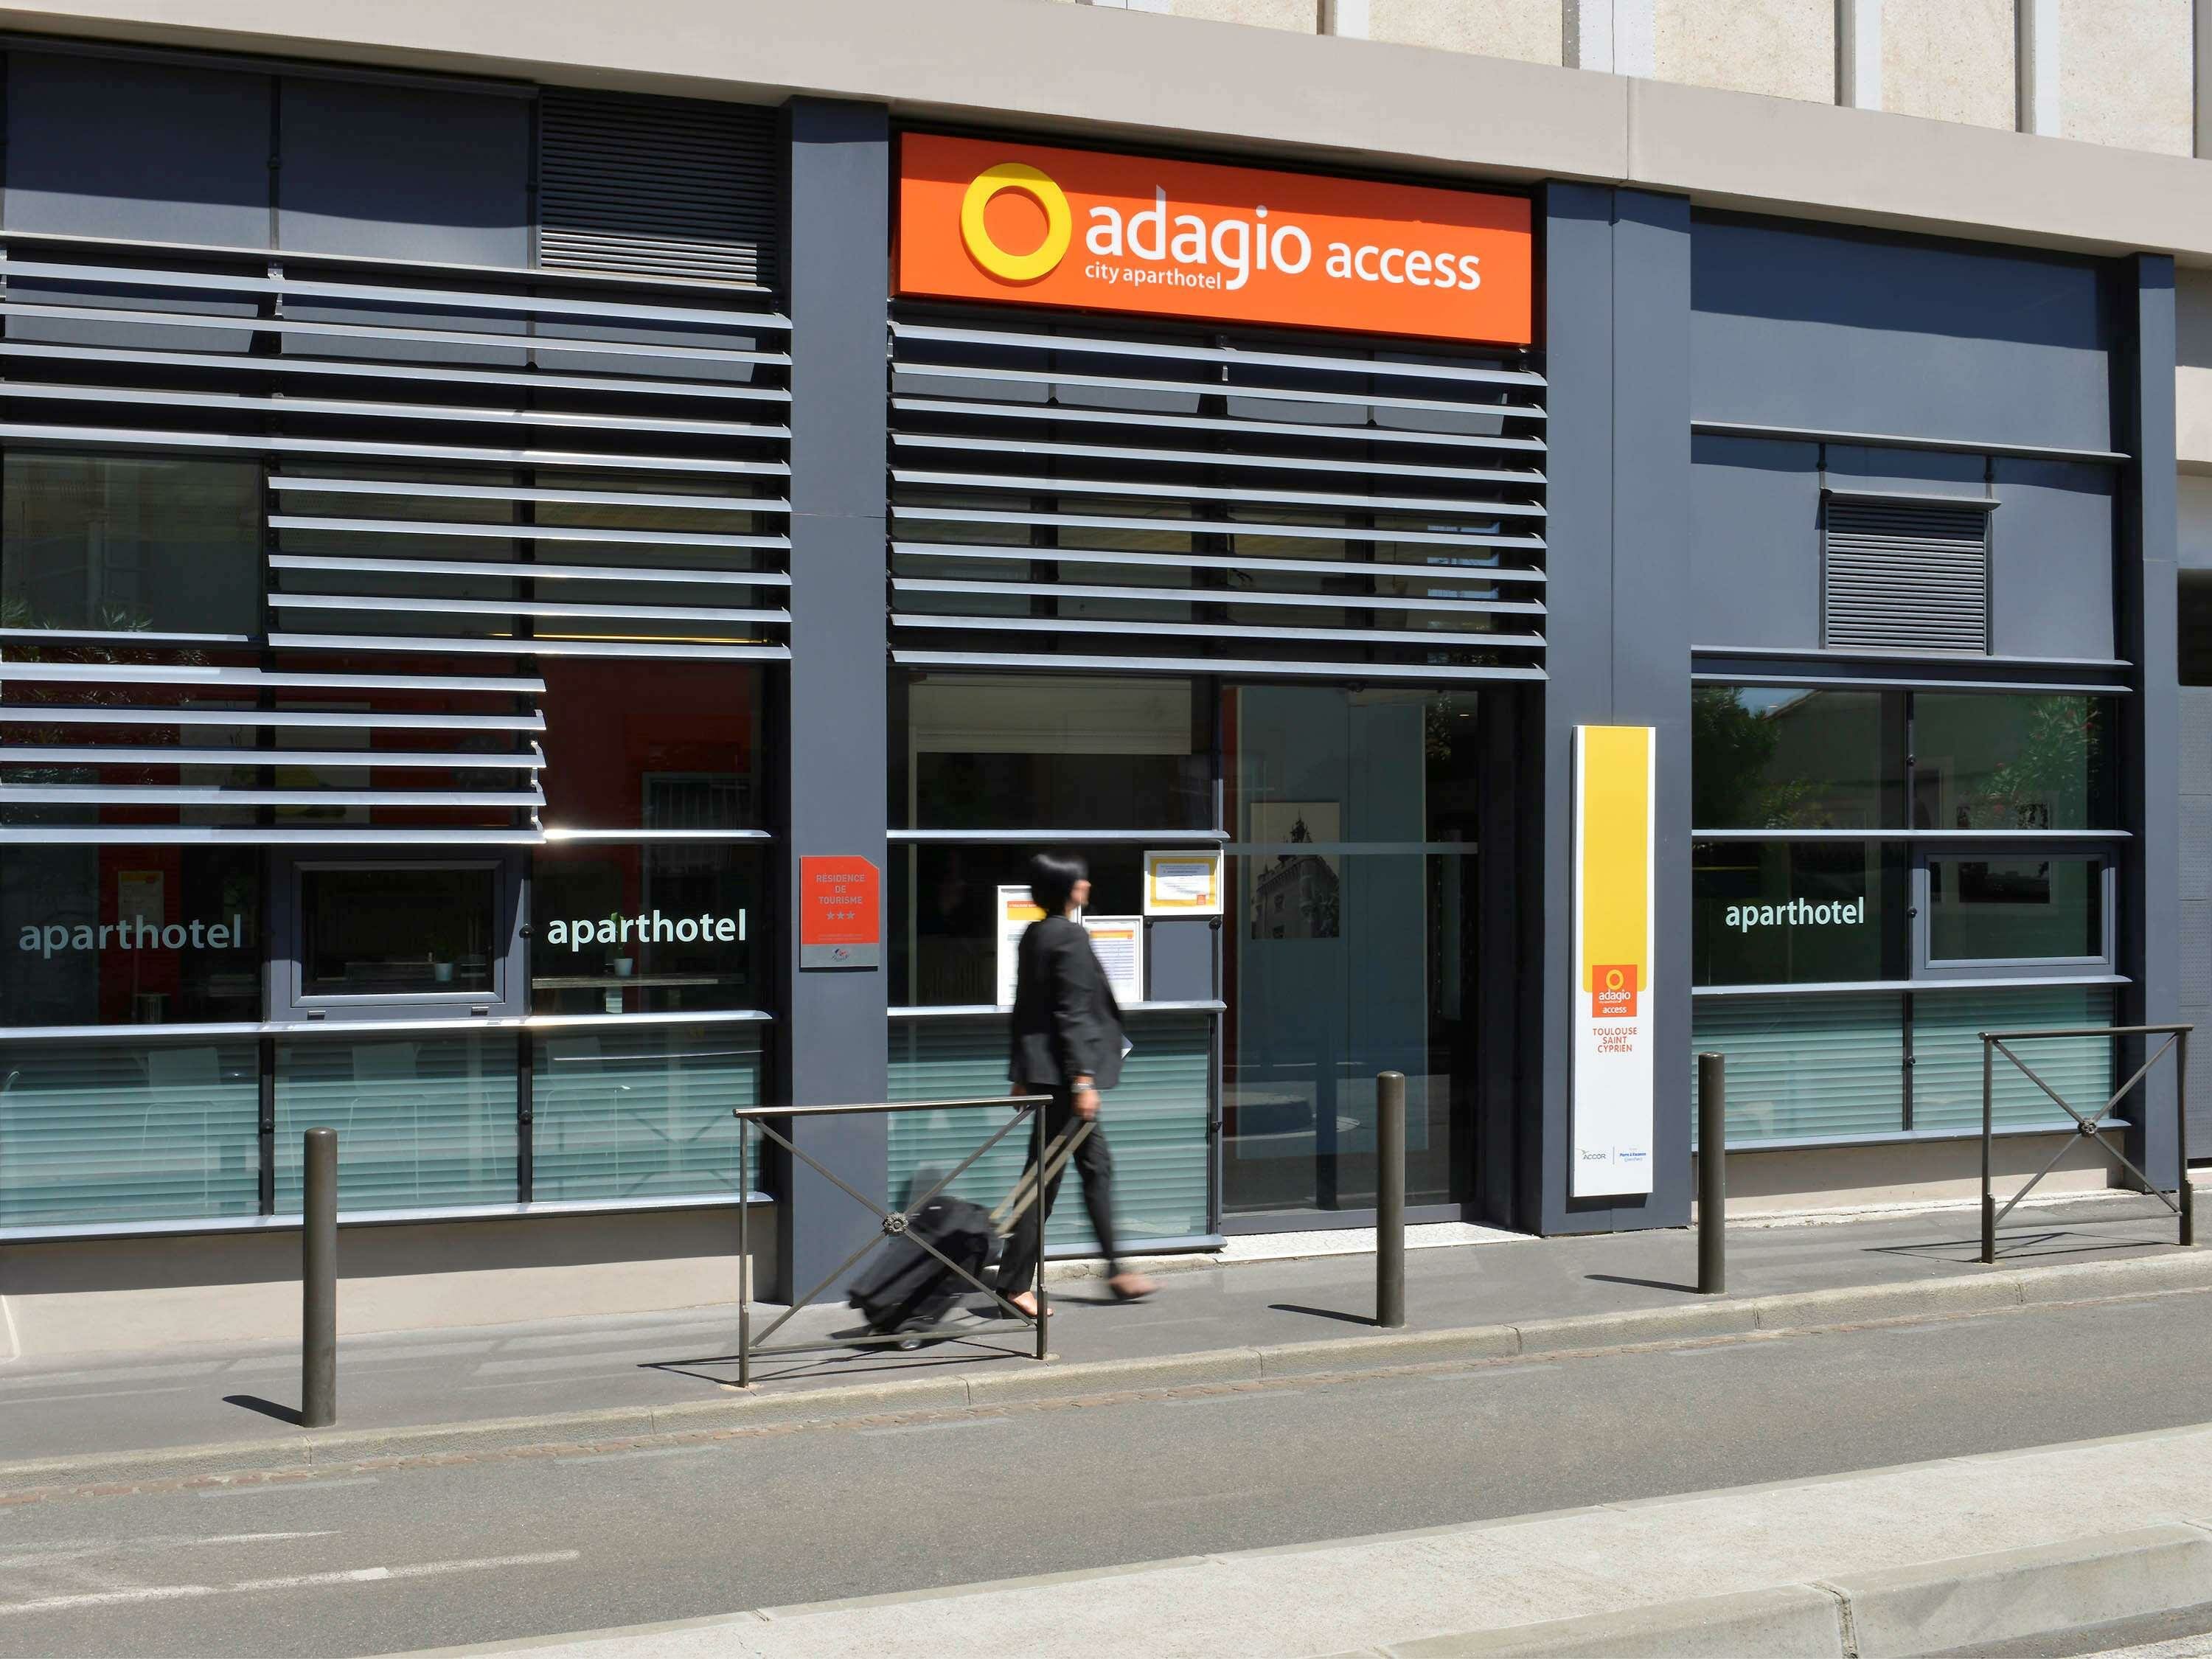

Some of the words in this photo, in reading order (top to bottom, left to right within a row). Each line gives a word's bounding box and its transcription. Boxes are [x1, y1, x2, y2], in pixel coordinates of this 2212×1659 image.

[1085, 184, 1311, 289] adagio
[1326, 237, 1481, 291] access
[1085, 262, 1119, 285] city
[1123, 266, 1222, 290] aparthotel
[816, 873, 865, 882] RÉSIDENCE
[835, 885, 846, 894] DE
[818, 896, 863, 905] TOURISME
[1725, 896, 1865, 933] aparthotel
[547, 908, 746, 953] aparthotel
[18, 914, 241, 959] aparthotel
[1599, 989, 1631, 1003] adagio
[1593, 1027, 1638, 1036] TOULOUSE
[1602, 1036, 1627, 1045] SAINT
[1597, 1044, 1632, 1053] CYPRIEN
